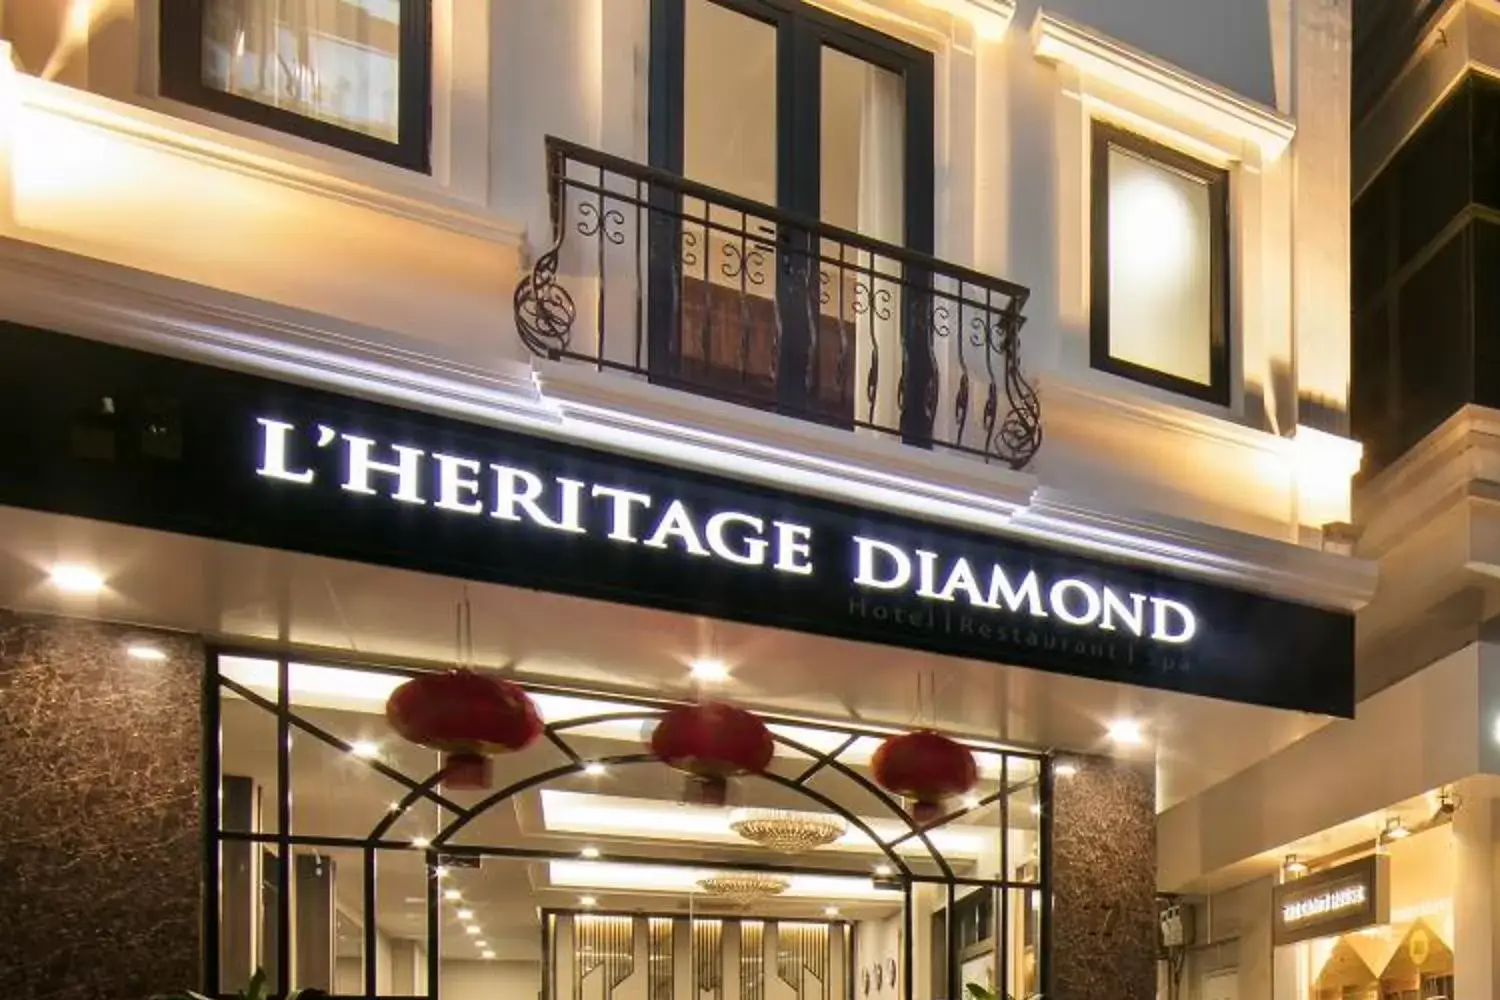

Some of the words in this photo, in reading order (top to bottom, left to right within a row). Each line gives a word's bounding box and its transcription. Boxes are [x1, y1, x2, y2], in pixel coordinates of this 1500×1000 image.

[255, 417, 814, 575] L'HERITAGE
[853, 535, 1198, 645] DIAMOND
[848, 596, 936, 631] Hotel
[960, 614, 1117, 661] Restaurant
